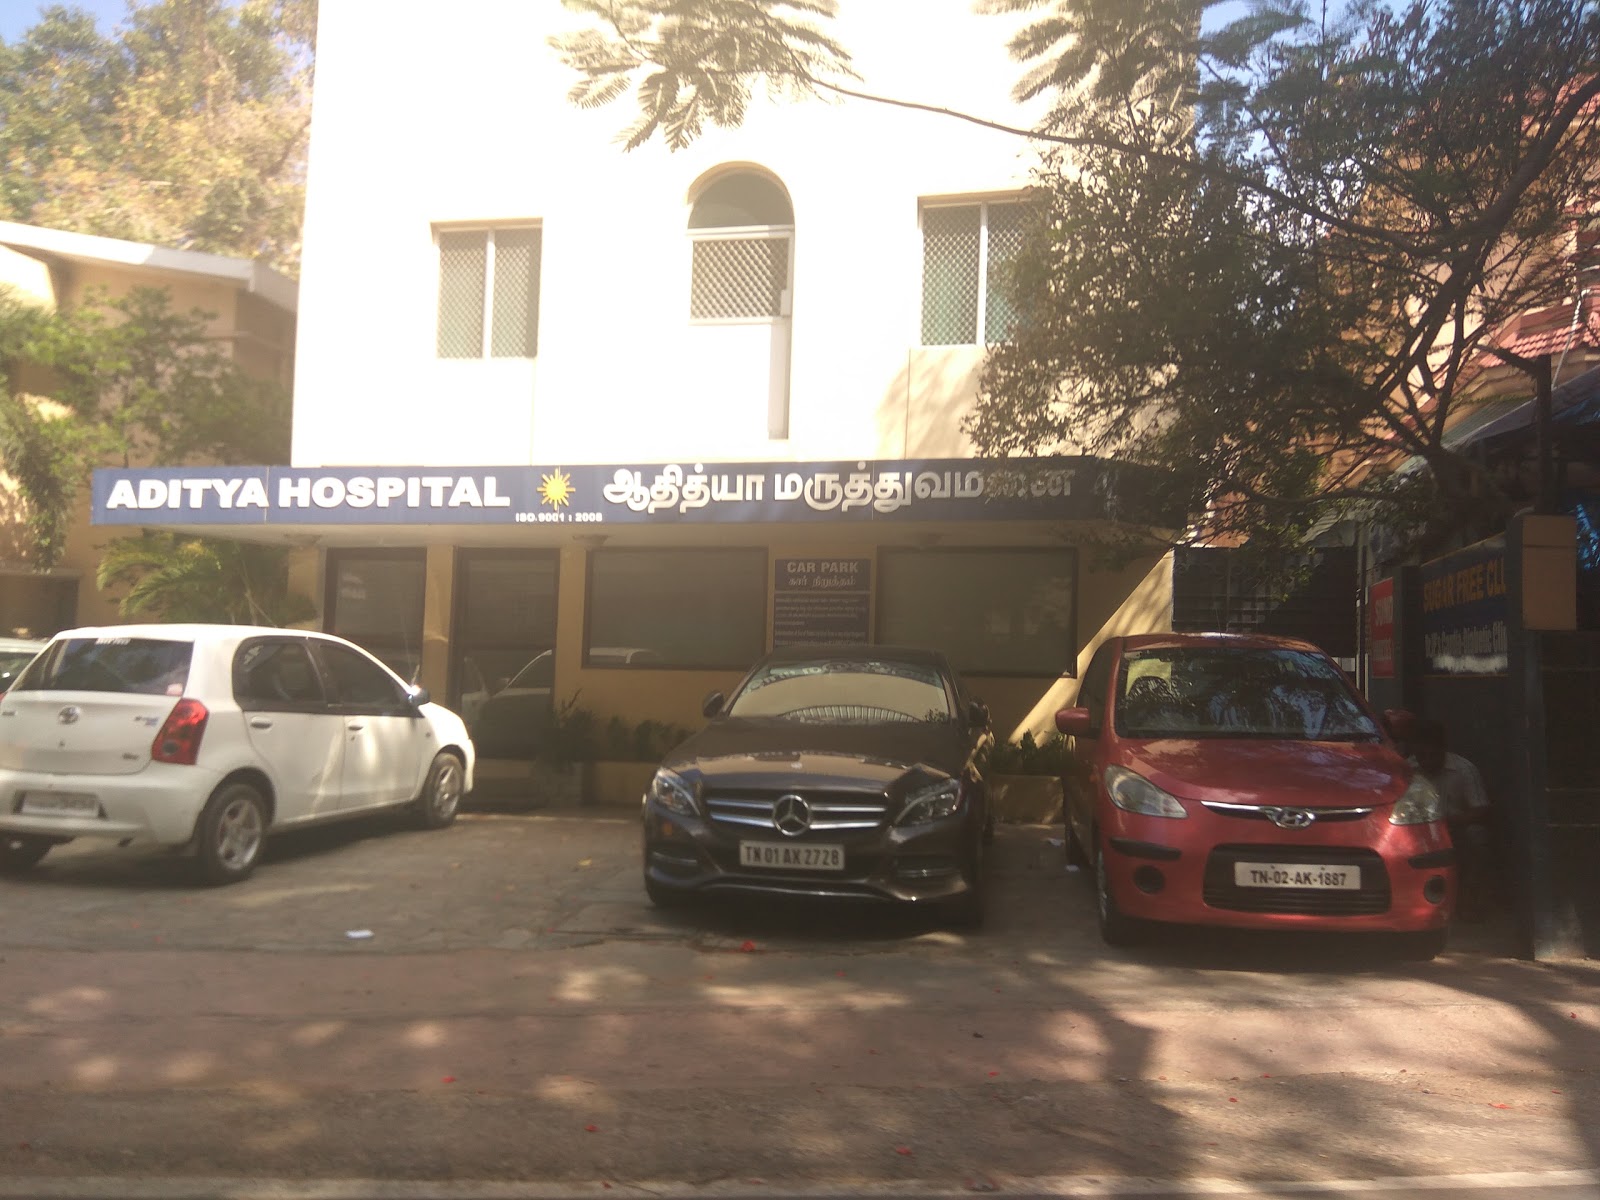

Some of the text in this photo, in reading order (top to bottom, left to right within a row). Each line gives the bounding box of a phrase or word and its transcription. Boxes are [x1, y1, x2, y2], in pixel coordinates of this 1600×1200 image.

[106, 476, 511, 509] ADITYA HOSPITAL
[603, 463, 765, 514] ஆதித்யா
[575, 512, 603, 522] 2008
[787, 562, 858, 573] CAR PARK
[745, 846, 839, 866] TN 01 AX 2728
